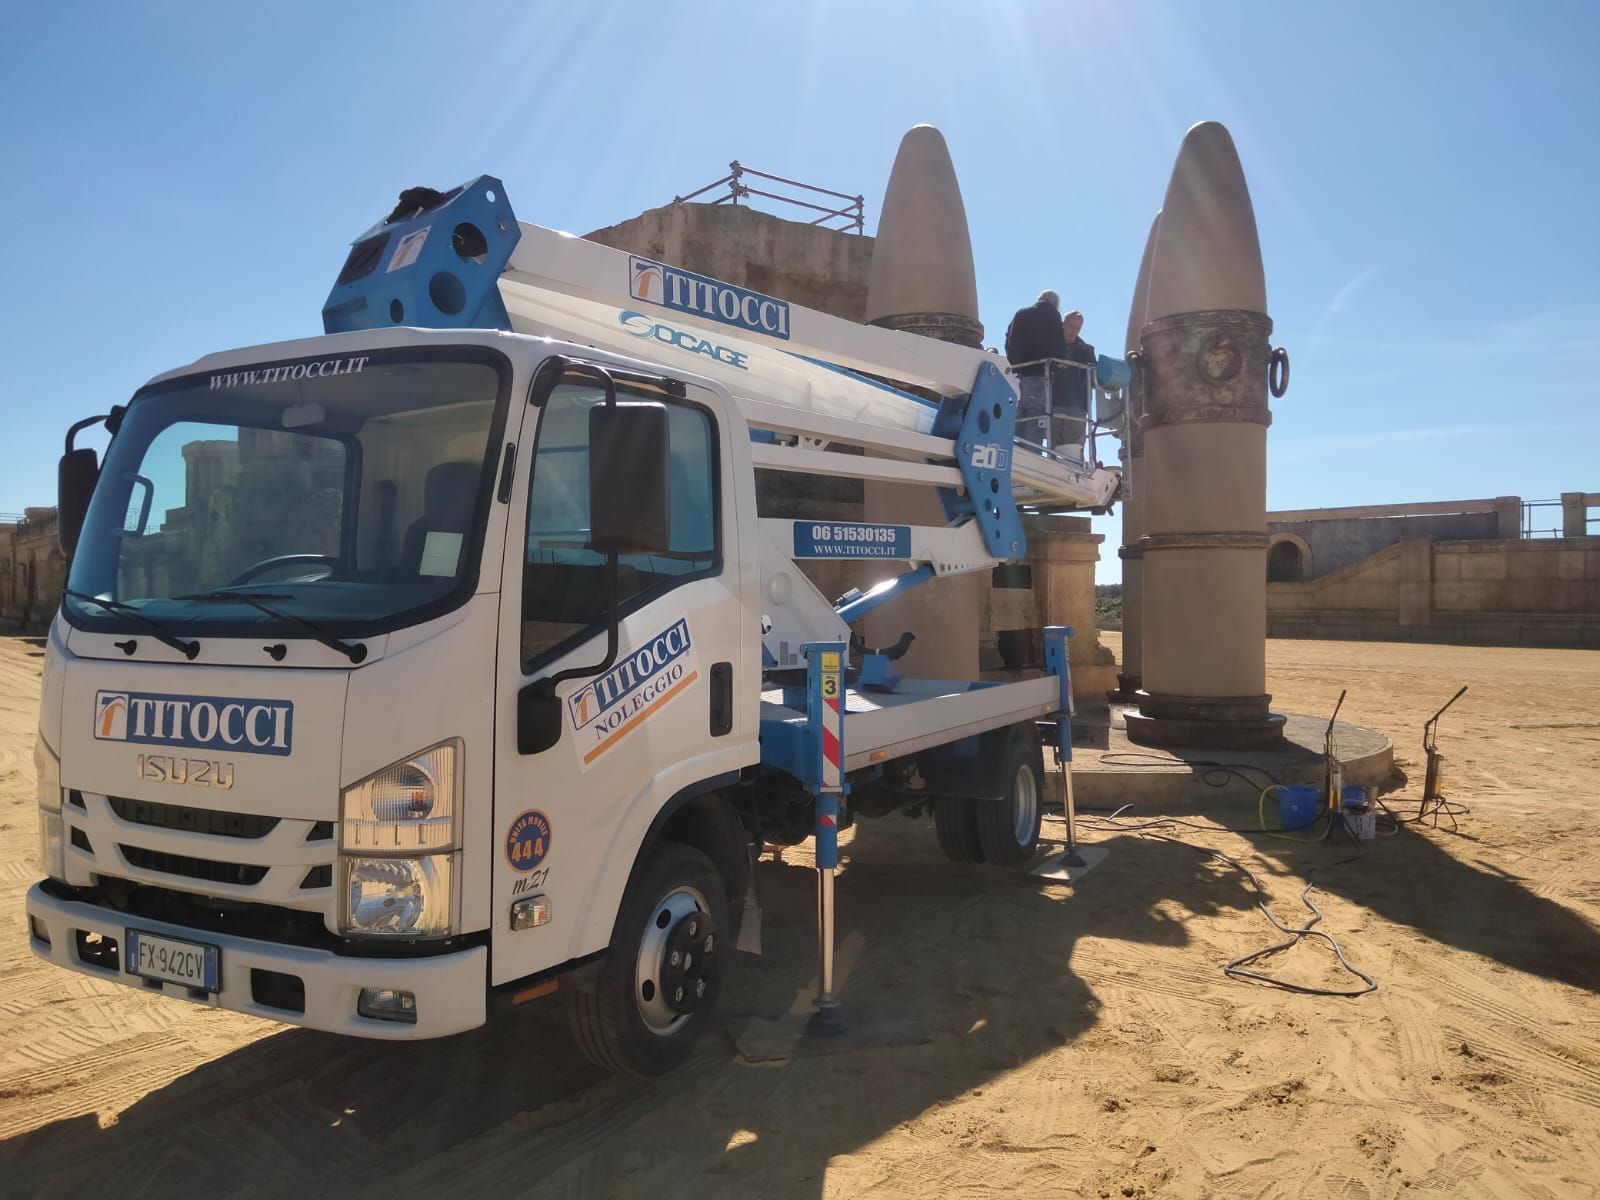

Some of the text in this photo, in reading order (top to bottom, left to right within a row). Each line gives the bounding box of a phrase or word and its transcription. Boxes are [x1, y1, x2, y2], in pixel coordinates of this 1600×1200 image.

[666, 271, 788, 335] TITOCCI
[619, 310, 749, 371] SOCAGE
[209, 356, 369, 391] WWW.TITOCCI.IT
[812, 525, 896, 542] 06 51530135
[814, 545, 896, 556] WWW.TITOCCI.IT
[596, 622, 689, 705] TITOCCI
[594, 664, 683, 740] NOLEGGIO
[824, 679, 837, 695] 3
[130, 698, 290, 748] TITOCCI
[136, 753, 235, 790] ISUZU
[511, 837, 544, 862] 444
[139, 942, 156, 969] FX
[160, 947, 203, 980] 942GV
